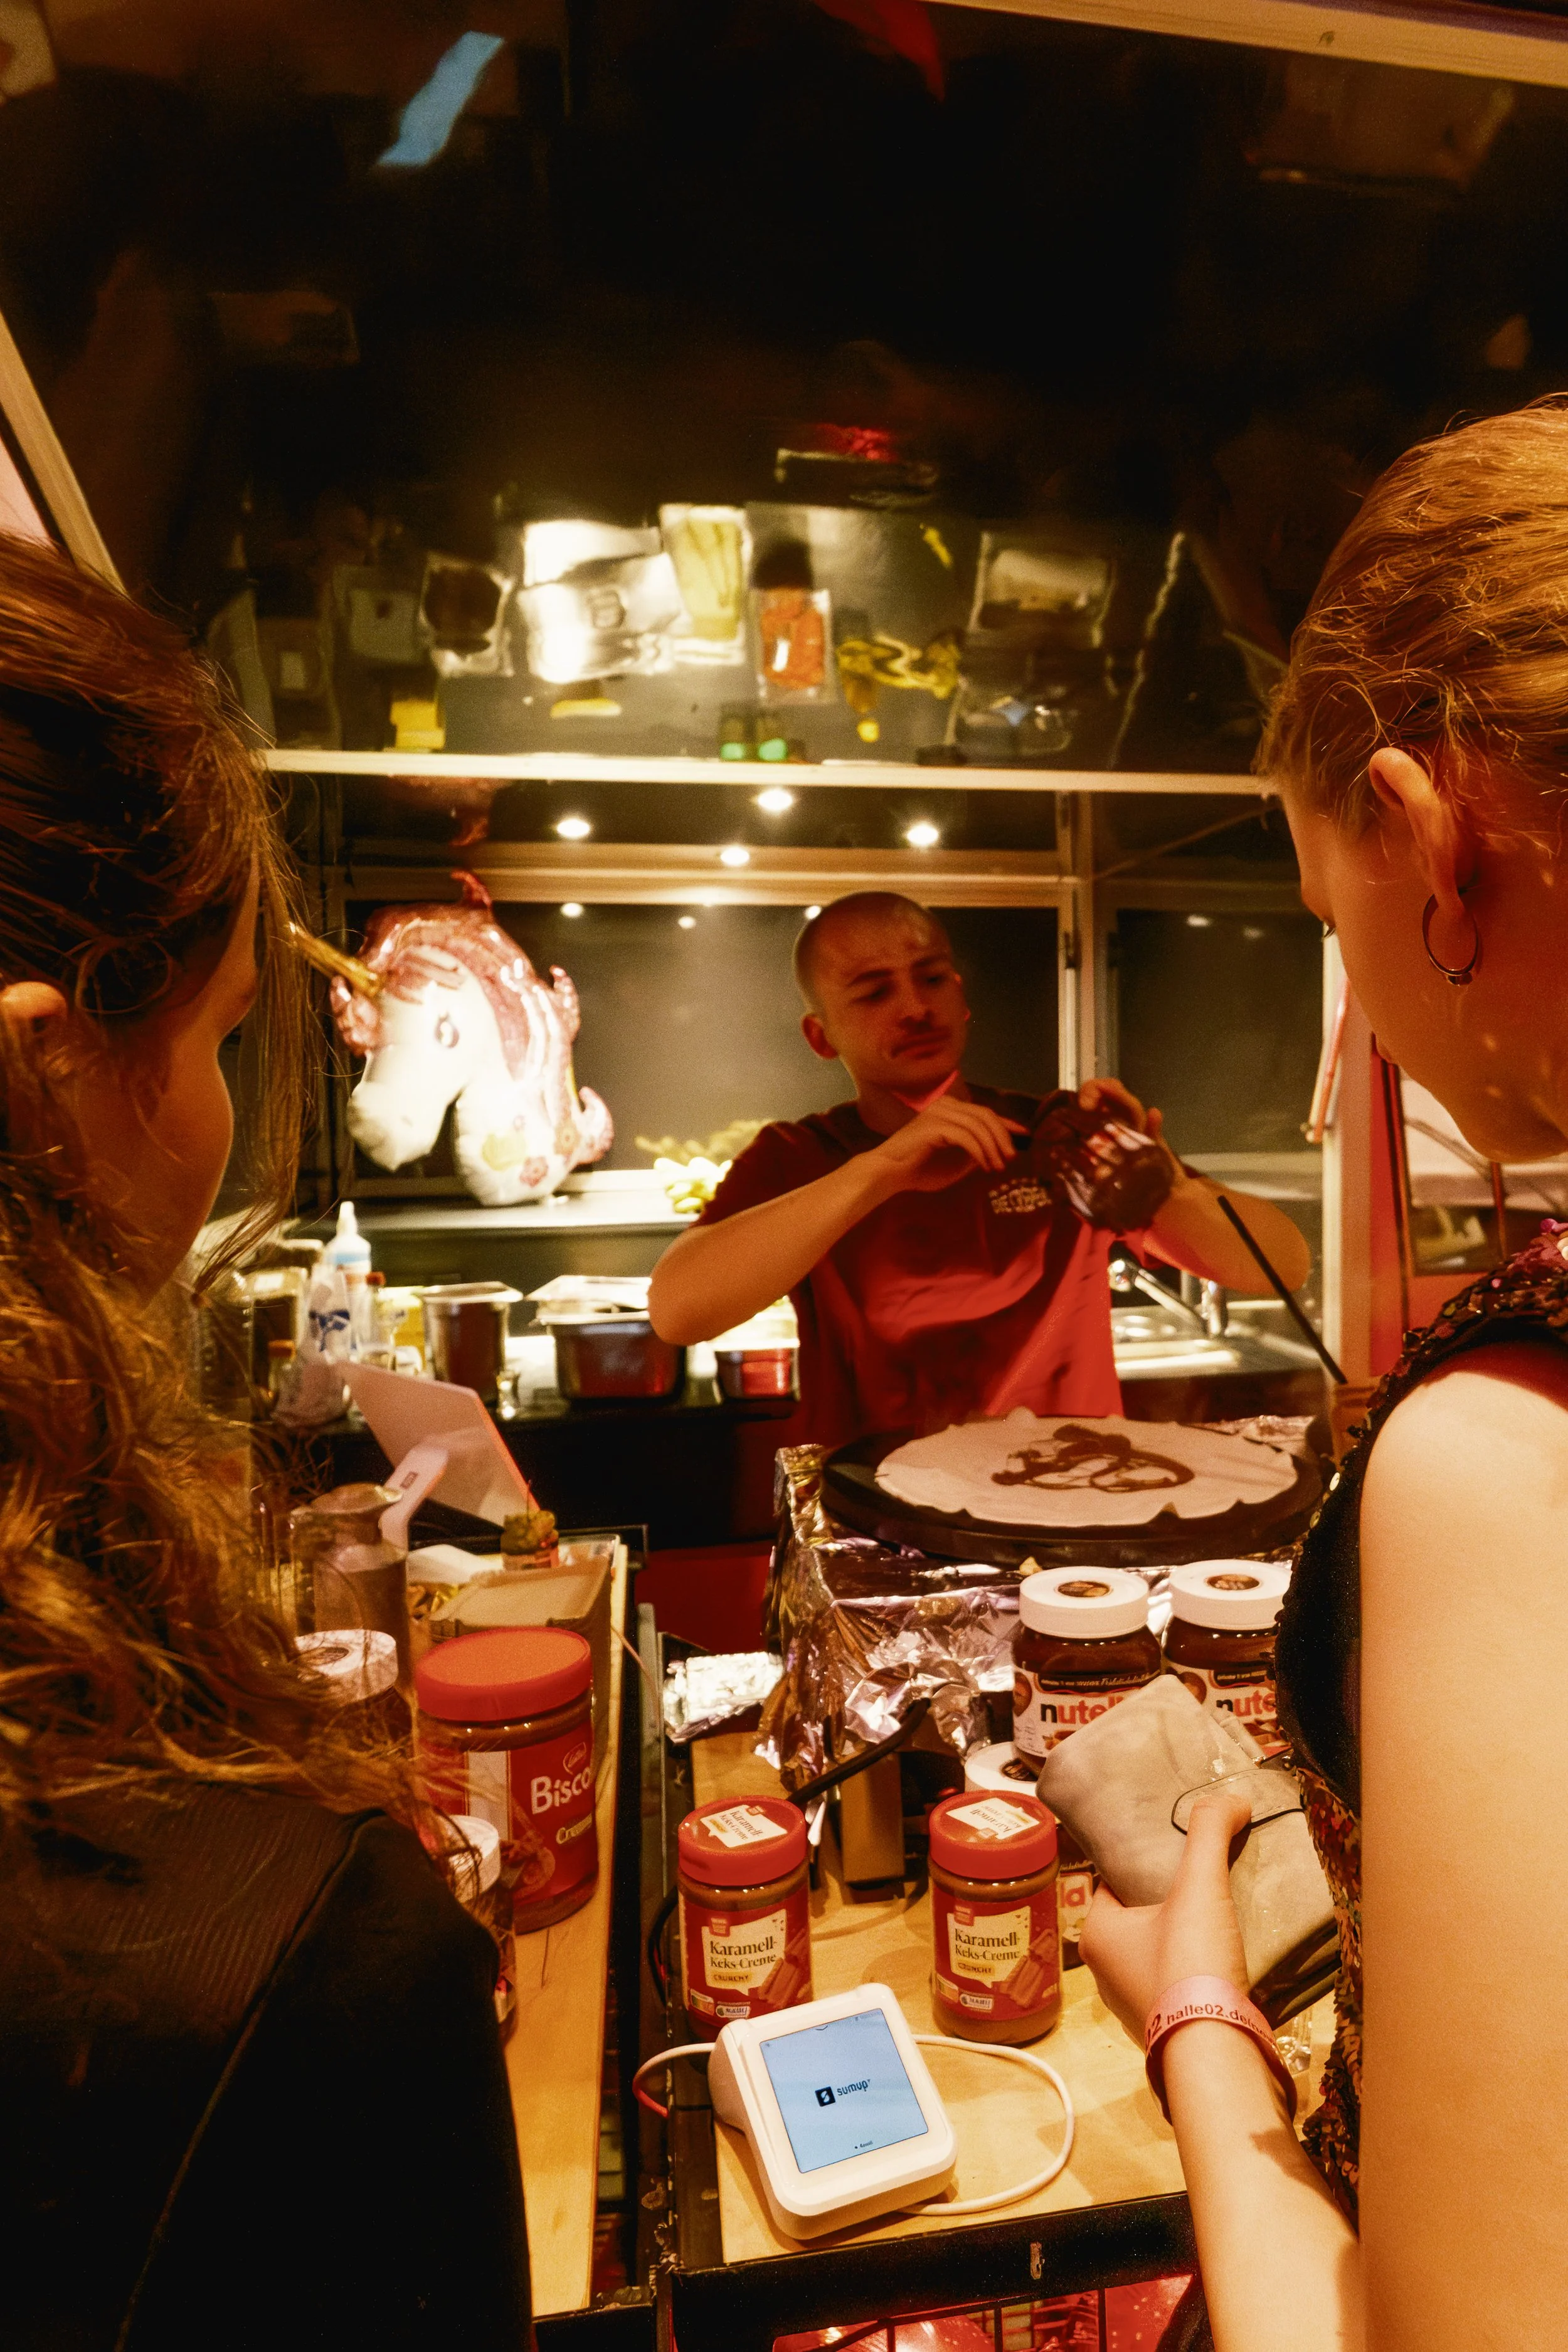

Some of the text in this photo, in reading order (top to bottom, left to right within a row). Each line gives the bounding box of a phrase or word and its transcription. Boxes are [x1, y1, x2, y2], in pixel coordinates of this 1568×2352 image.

[709, 1935, 778, 1956] Karamell-
[955, 1944, 1020, 1961] Keks-Creme
[710, 1953, 777, 1969] Keks-Creme
